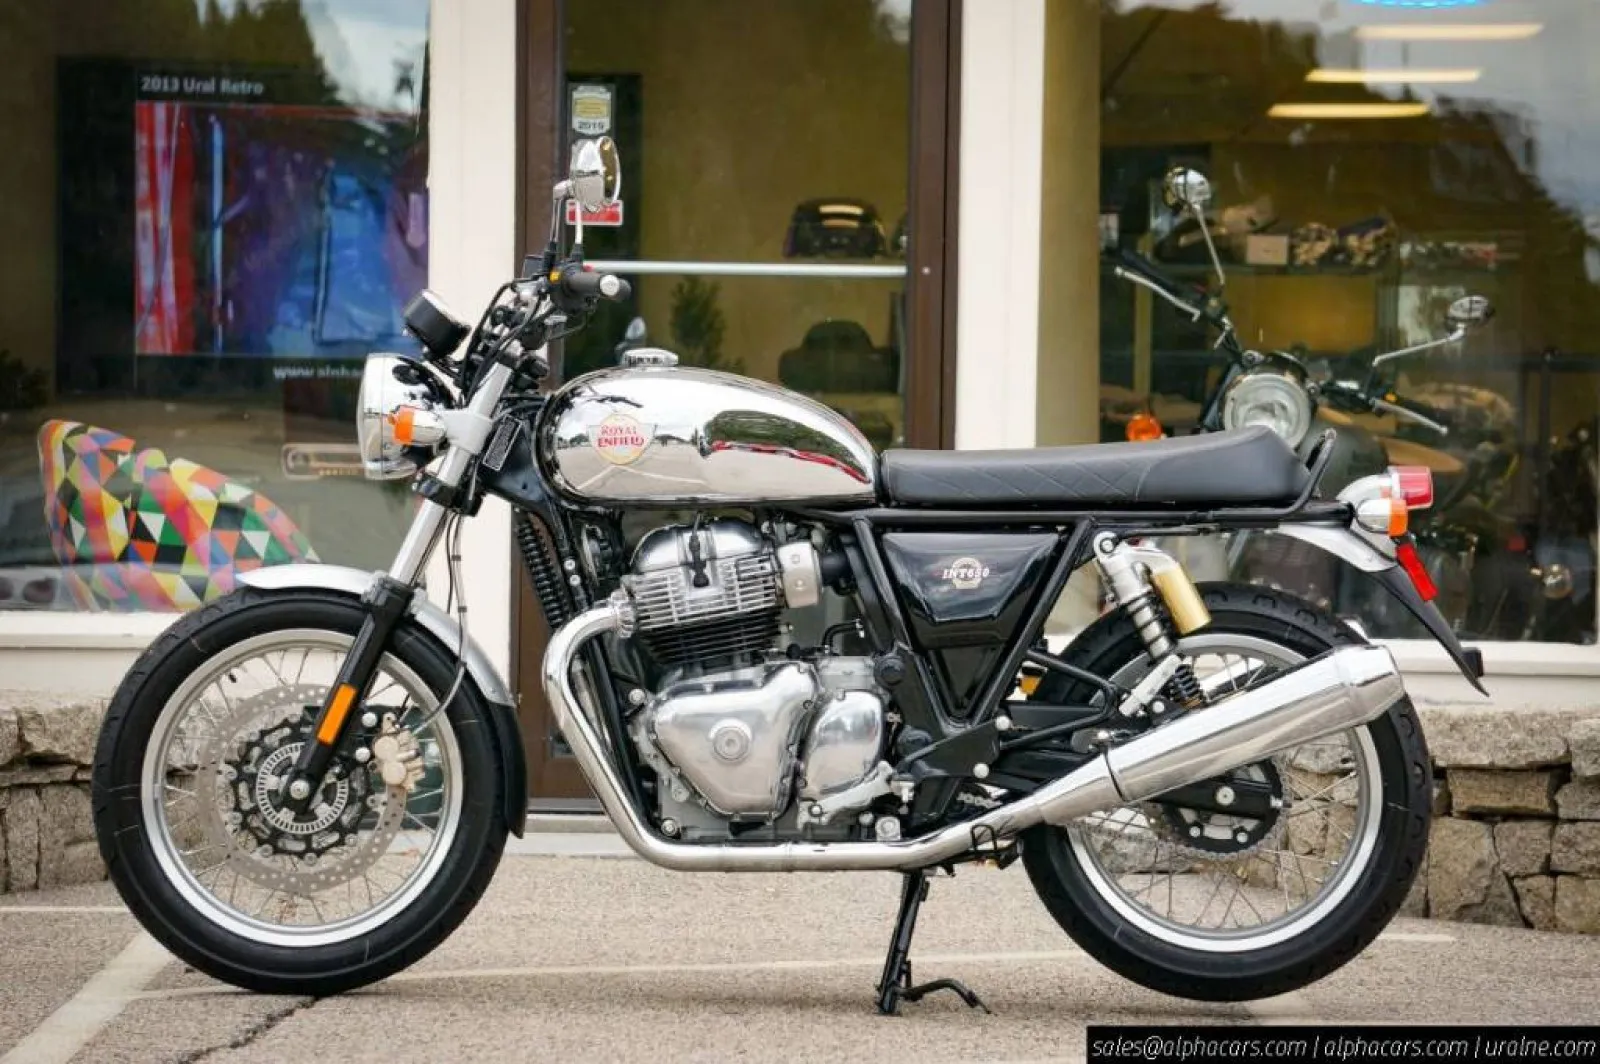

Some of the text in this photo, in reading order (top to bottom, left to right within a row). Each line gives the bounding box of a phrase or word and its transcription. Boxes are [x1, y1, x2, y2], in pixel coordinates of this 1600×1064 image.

[141, 75, 264, 95] 2013 Ural Retro
[601, 425, 637, 435] ROYAL
[942, 567, 990, 579] INT650
